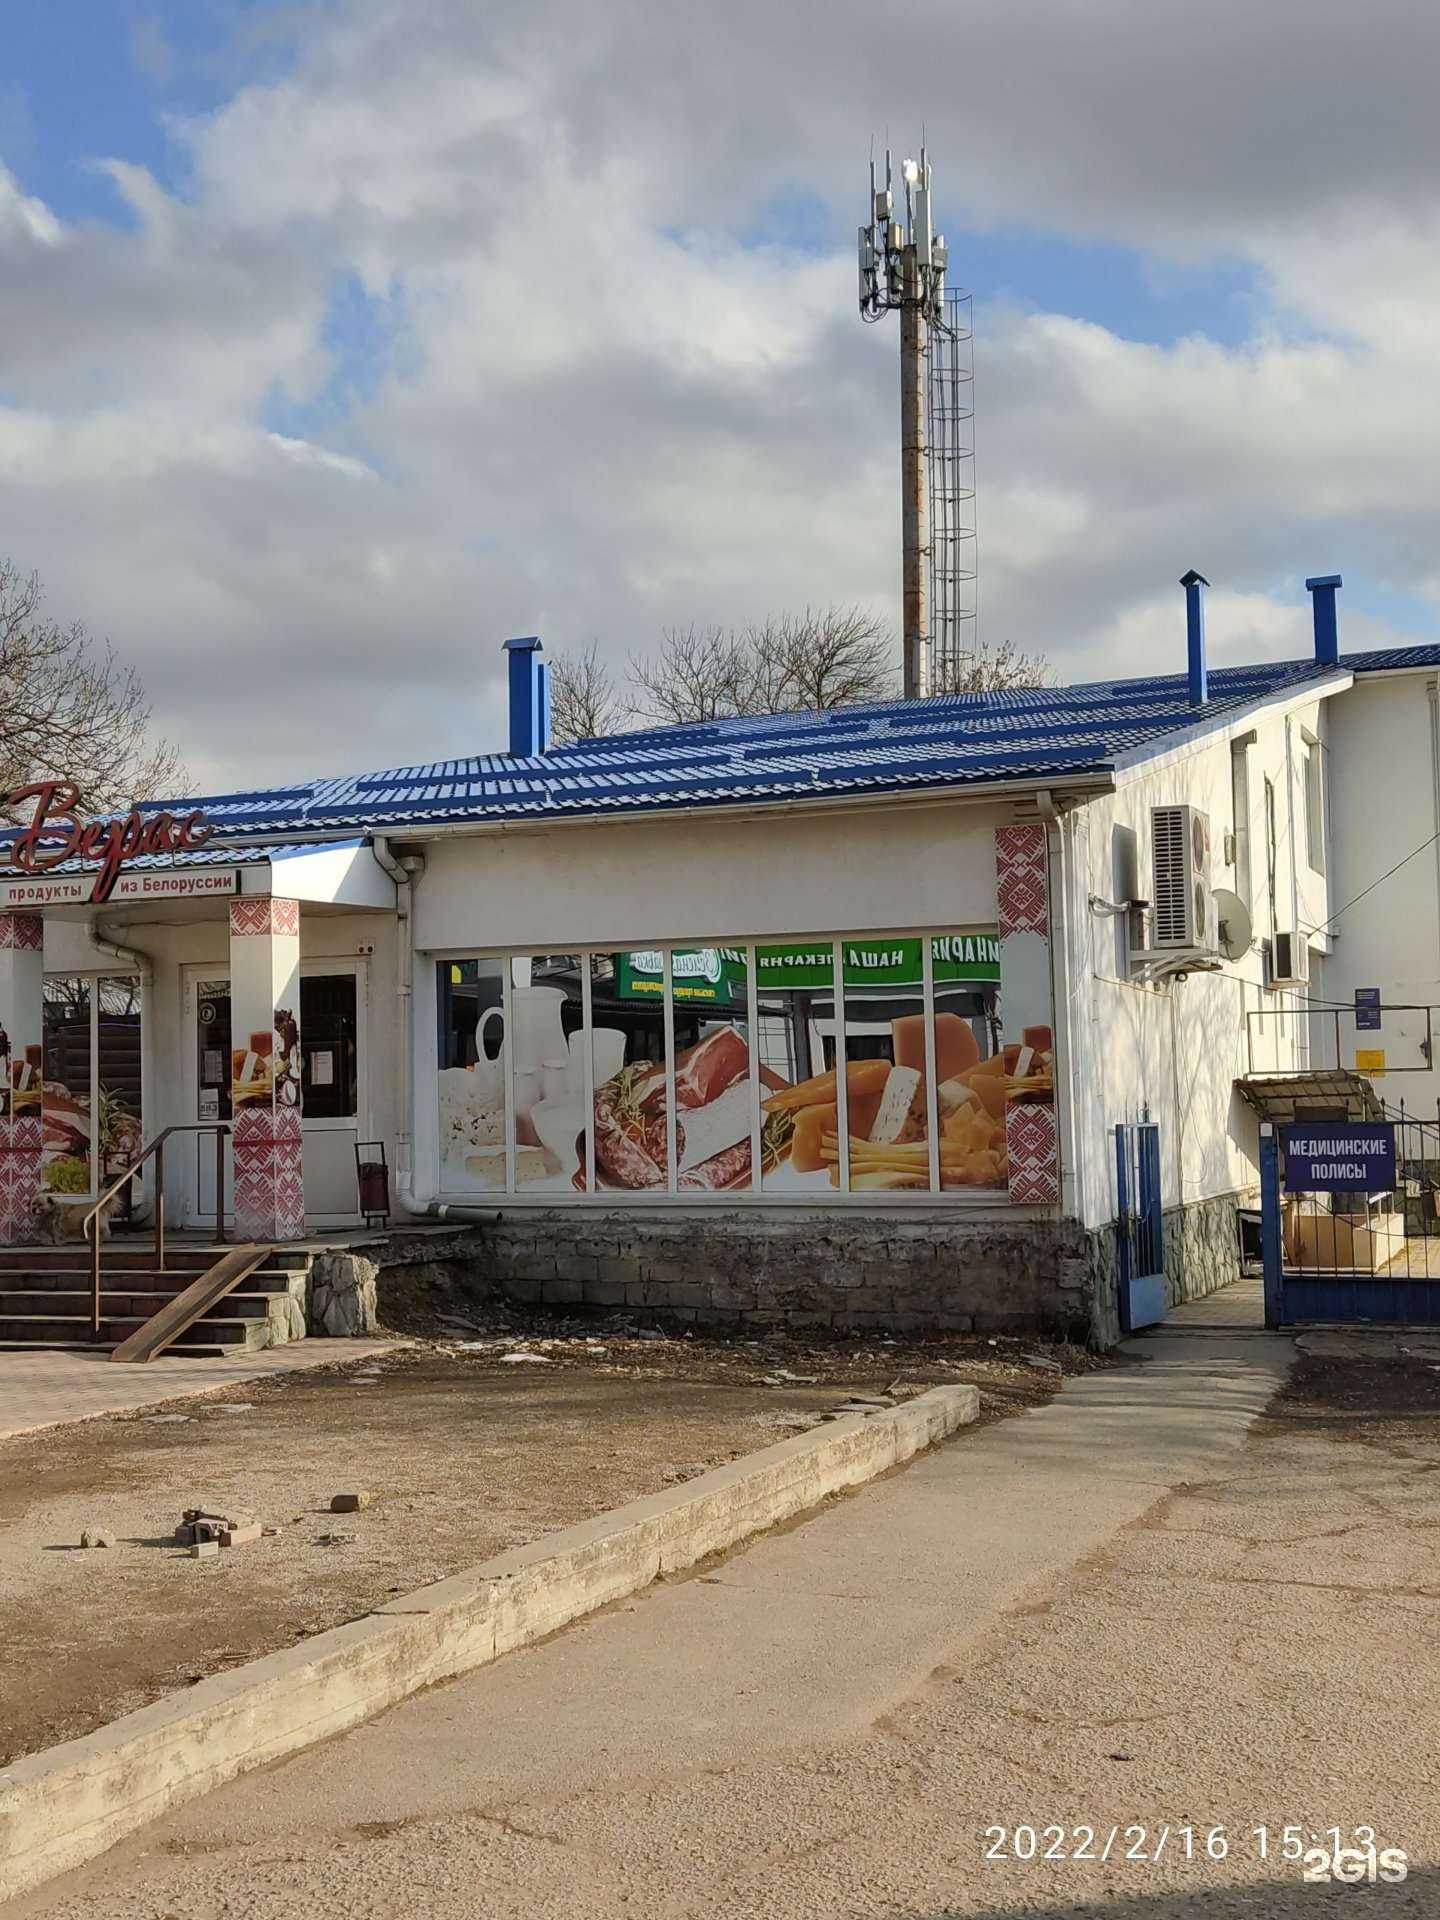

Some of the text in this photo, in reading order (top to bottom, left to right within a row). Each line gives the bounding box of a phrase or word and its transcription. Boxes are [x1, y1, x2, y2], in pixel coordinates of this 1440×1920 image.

[8, 780, 214, 904] Верас
[9, 876, 232, 902] продукты из Белоруссии
[1289, 1139, 1388, 1158] МЕДИЦИНСКИЕ
[1311, 1163, 1367, 1180] ПОЛИСЫ
